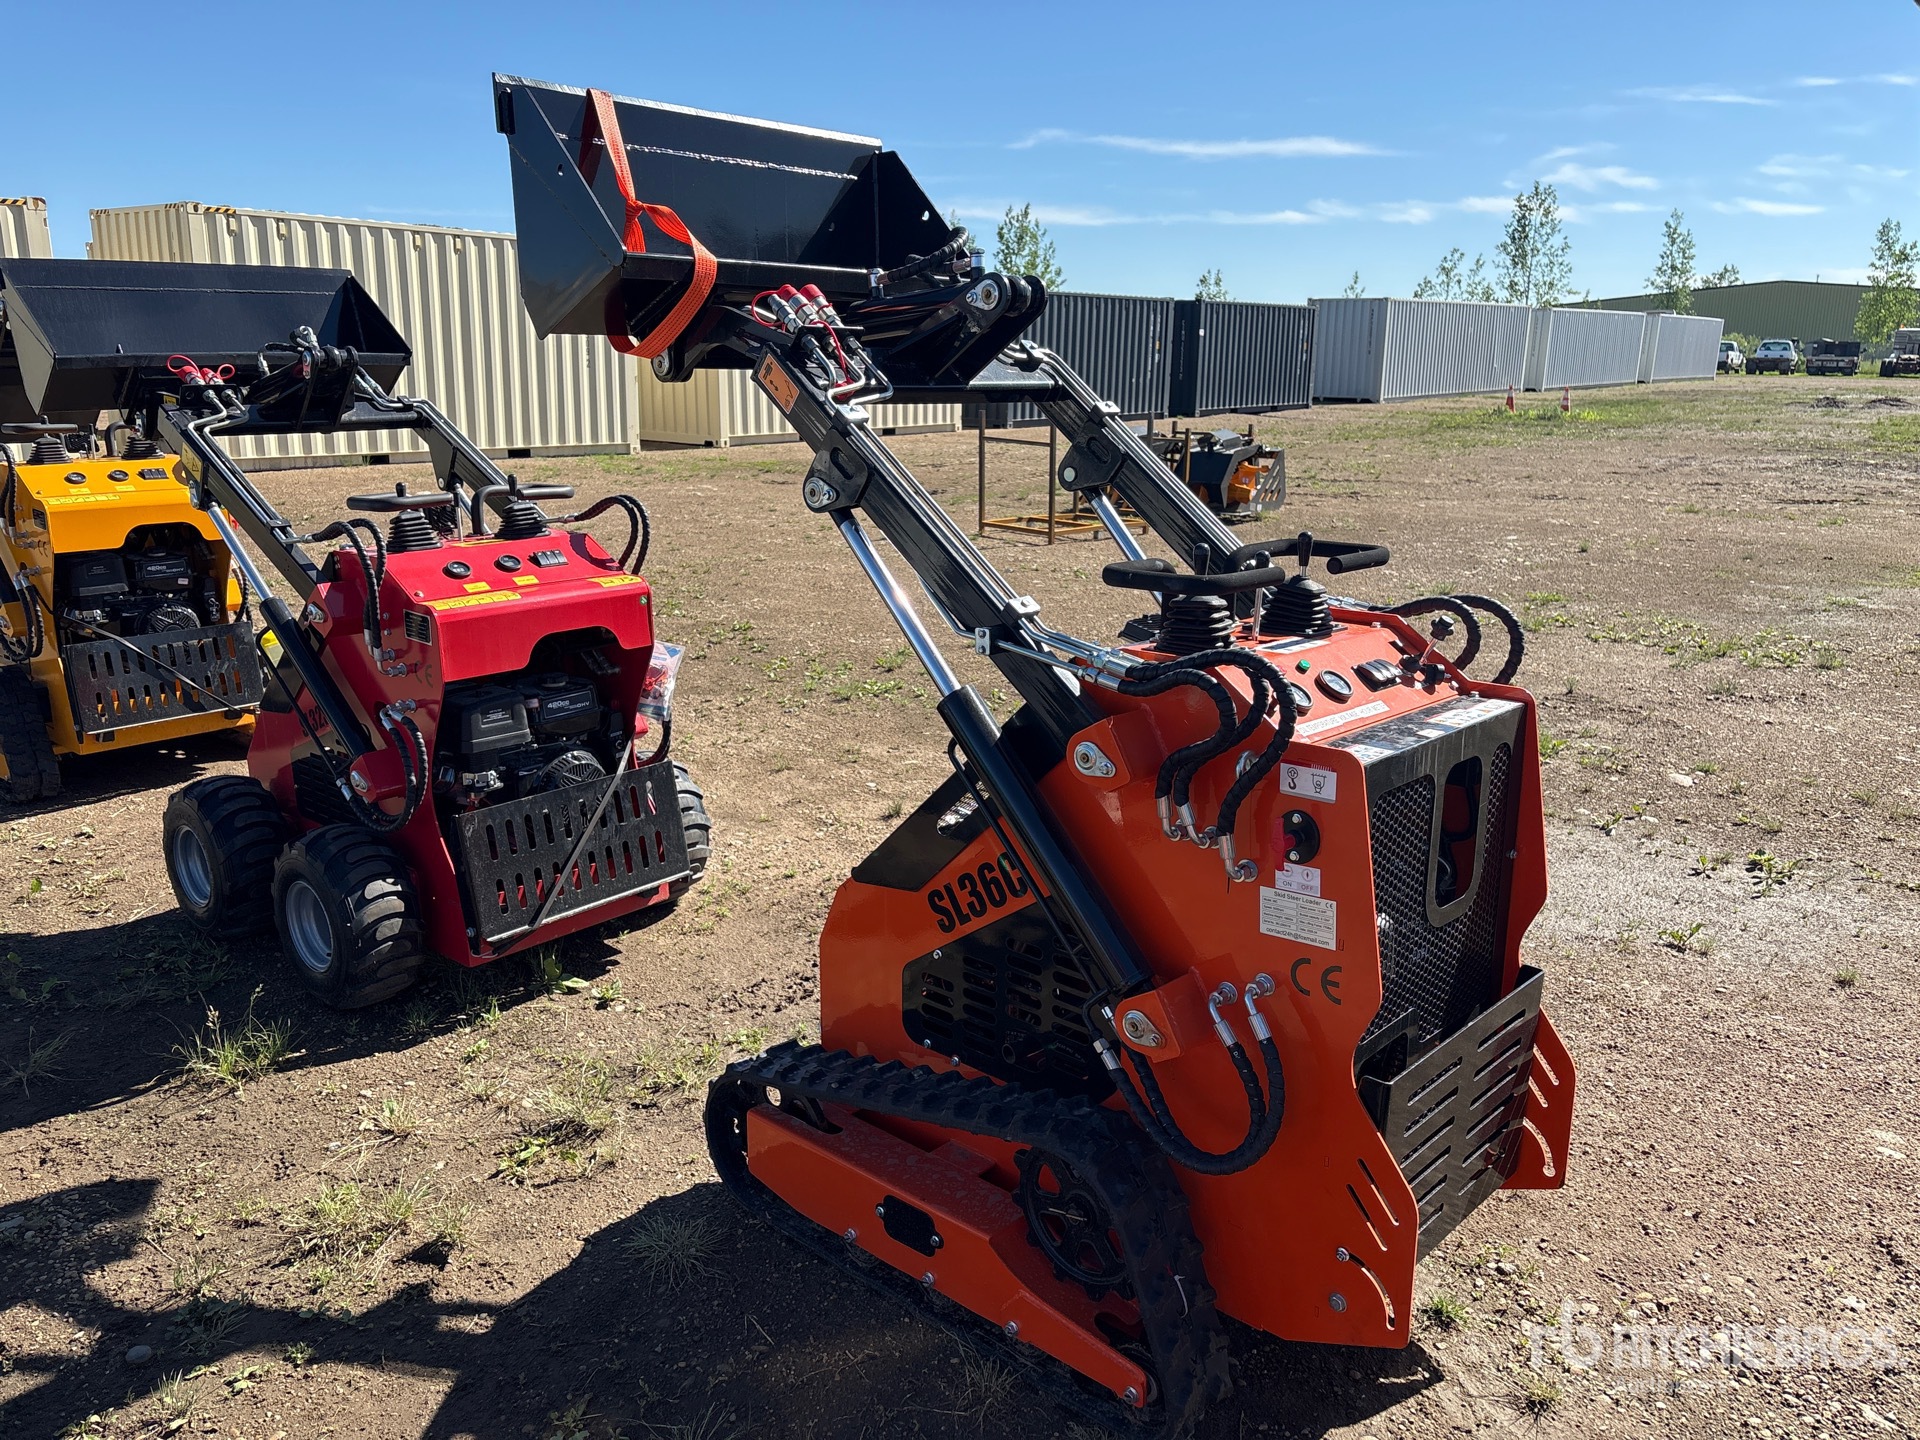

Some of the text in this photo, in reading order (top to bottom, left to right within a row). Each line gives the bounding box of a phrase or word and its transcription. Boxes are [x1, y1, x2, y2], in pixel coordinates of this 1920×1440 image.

[547, 699, 570, 709] 420cc
[1273, 891, 1286, 899] Skid
[1286, 894, 1302, 902] Steer
[1302, 897, 1322, 906] Loader
[1325, 902, 1334, 910] CE
[1265, 927, 1330, 946] contact24h@foxmail.com
[1291, 957, 1342, 1006] CE
